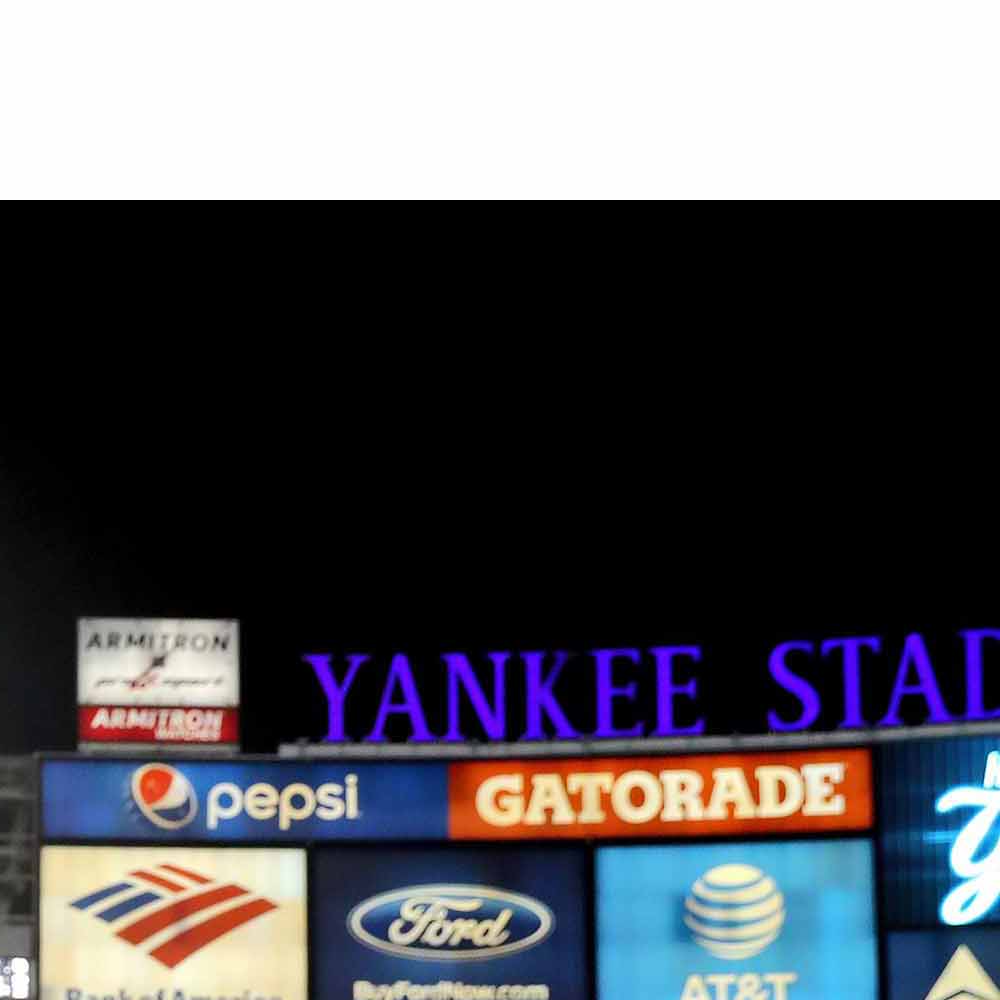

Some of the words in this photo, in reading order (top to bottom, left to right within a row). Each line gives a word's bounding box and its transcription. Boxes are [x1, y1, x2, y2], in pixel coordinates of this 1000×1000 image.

[87, 632, 231, 650] ARMITRON
[91, 708, 223, 731] ARMITRON
[303, 645, 706, 742] YANKEE
[206, 773, 359, 830] pepsi
[475, 763, 846, 827] GATORADE
[388, 898, 512, 946] Ford
